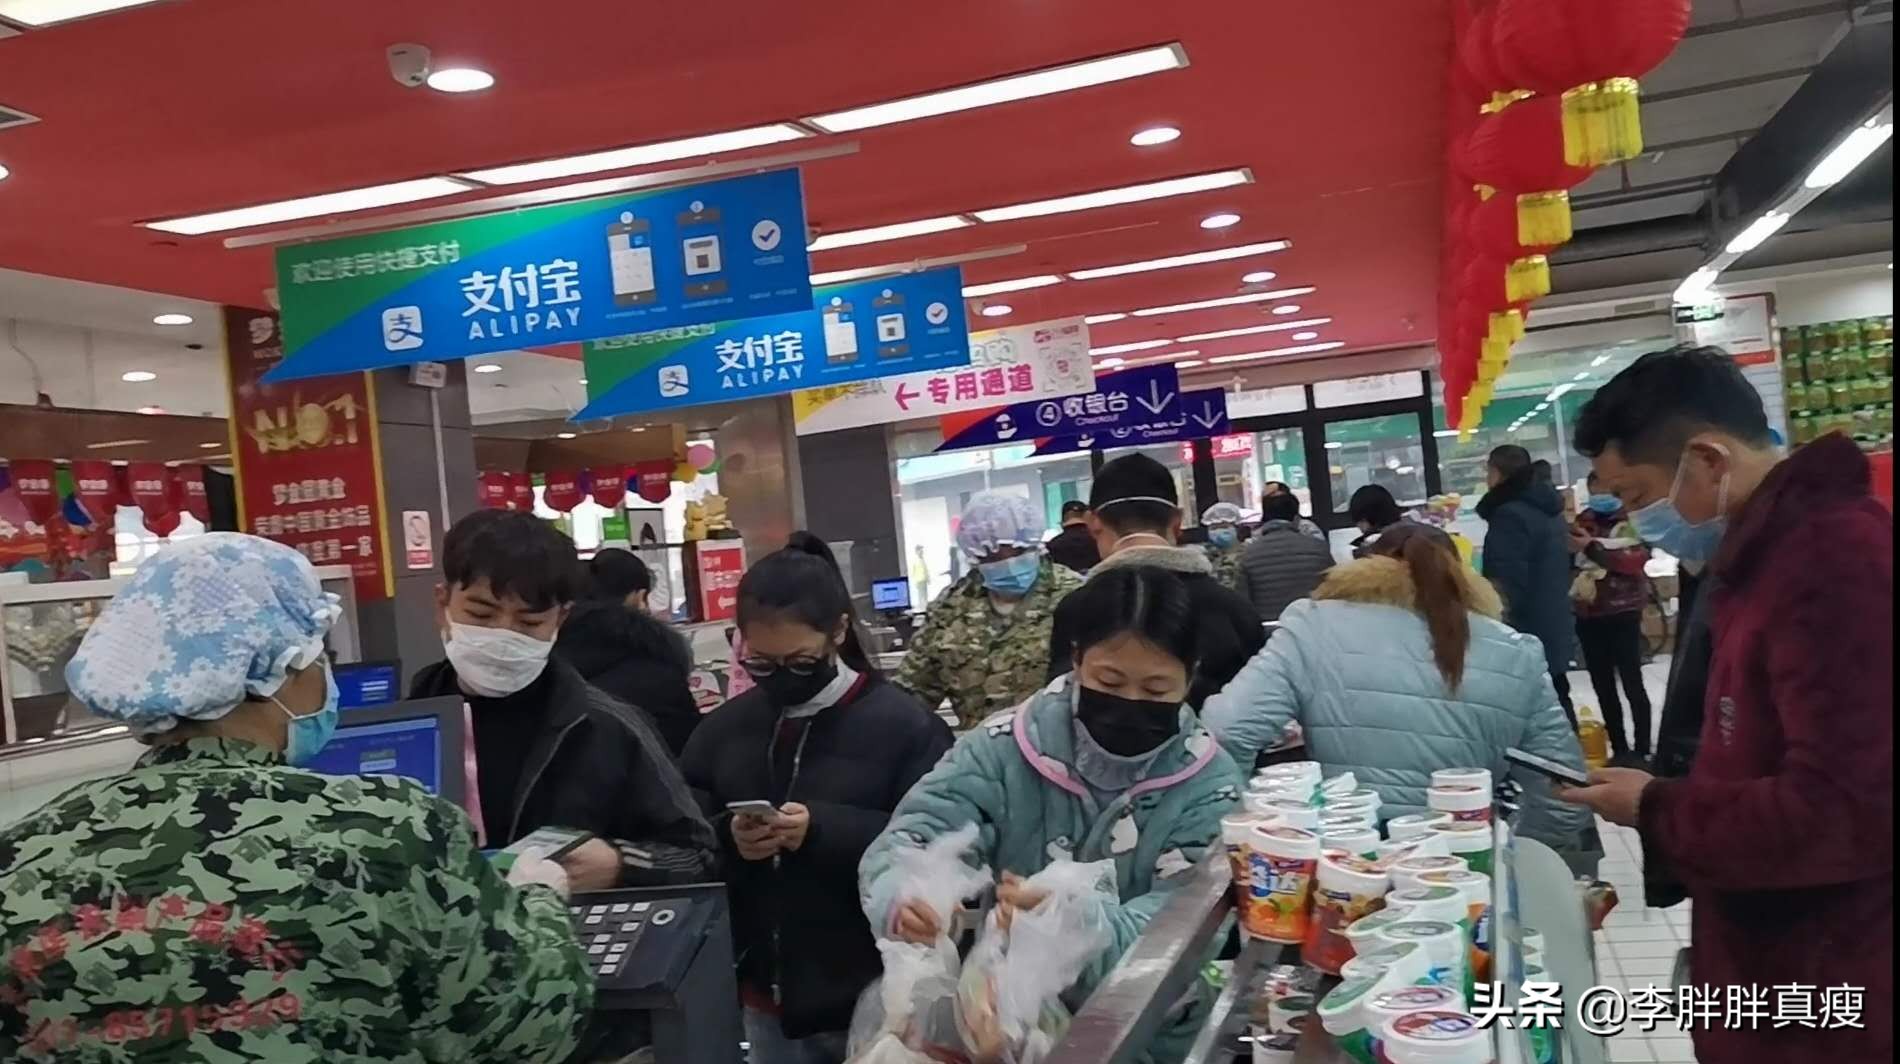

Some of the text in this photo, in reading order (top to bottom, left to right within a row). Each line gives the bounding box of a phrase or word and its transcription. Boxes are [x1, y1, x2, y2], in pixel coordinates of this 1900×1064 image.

[291, 239, 461, 284] 欢迎使用快捷支付
[458, 257, 583, 317] 支付宝
[468, 307, 582, 340] ALIPAY
[714, 329, 805, 374] 支付宝
[720, 363, 804, 390] ALIPAY
[926, 363, 1035, 406] 专用通道
[1063, 390, 1130, 418] 收银台
